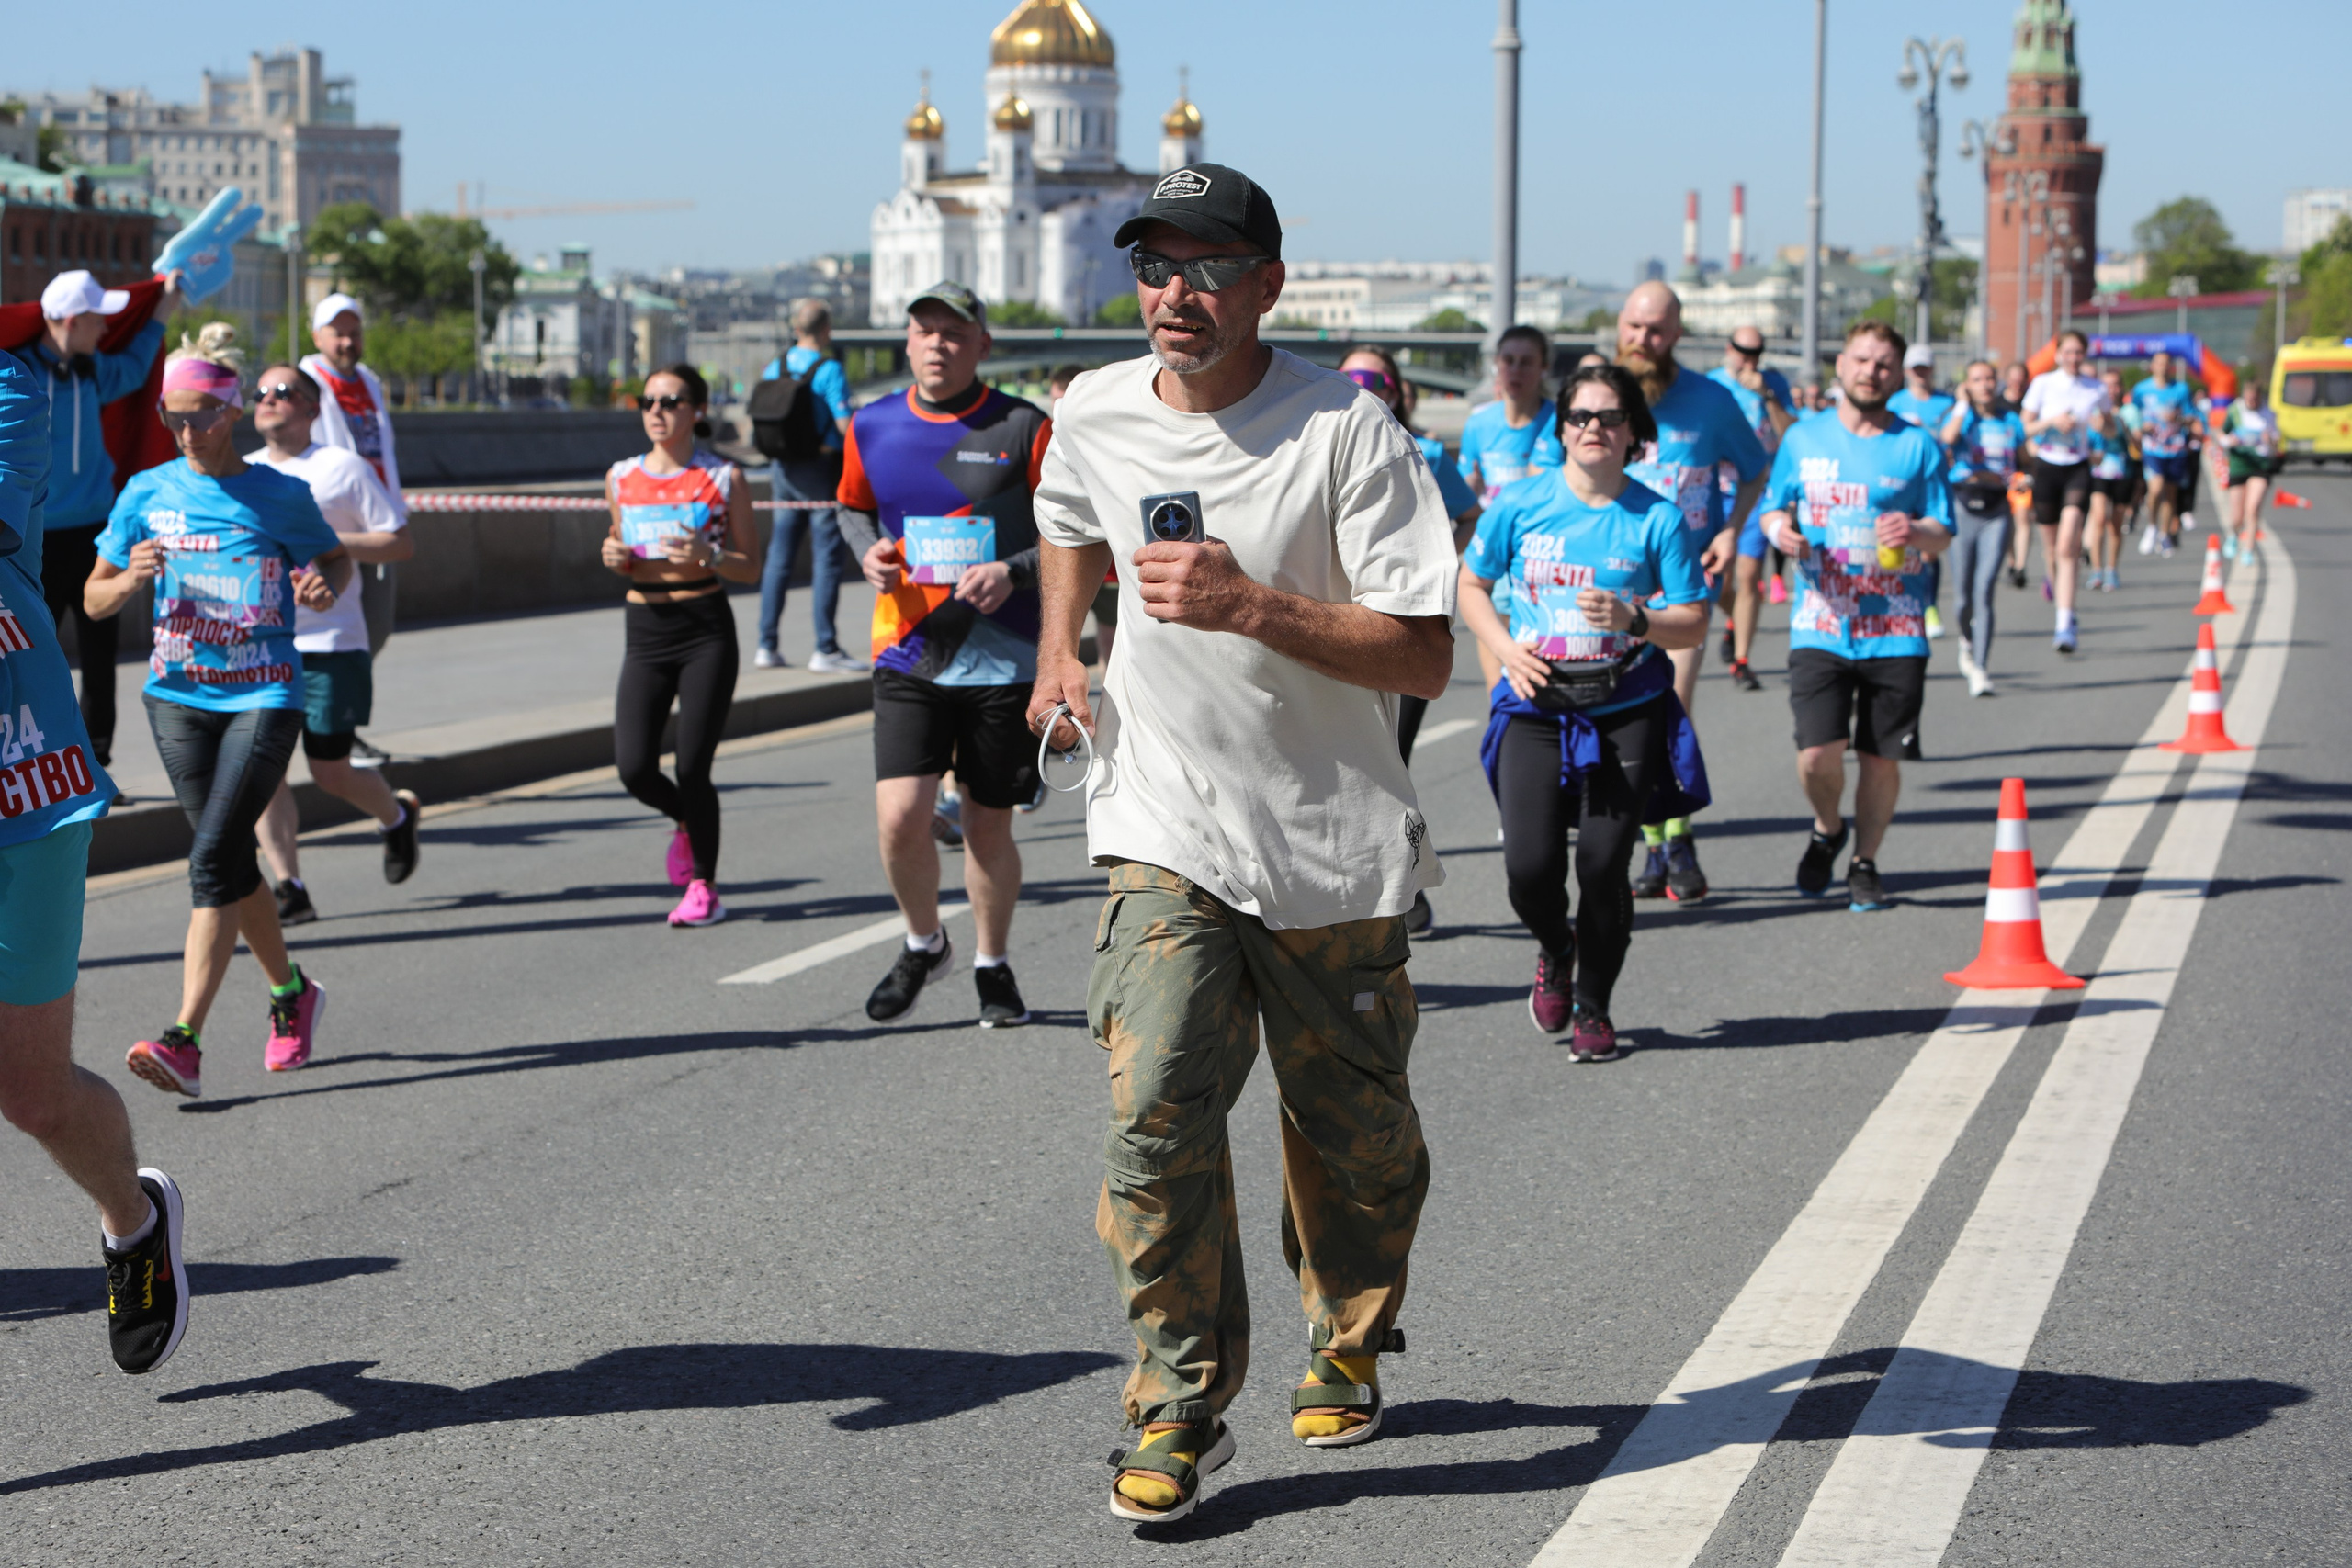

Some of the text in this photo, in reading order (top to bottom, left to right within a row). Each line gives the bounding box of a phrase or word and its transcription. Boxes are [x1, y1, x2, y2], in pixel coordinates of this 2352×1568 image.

[1165, 182, 1203, 190] PROTEST
[921, 537, 978, 561] 33932
[1519, 532, 1566, 561] 2024
[183, 572, 241, 601] 30610
[1523, 558, 1596, 588] #МЕЧТА
[225, 641, 273, 671] 2024
